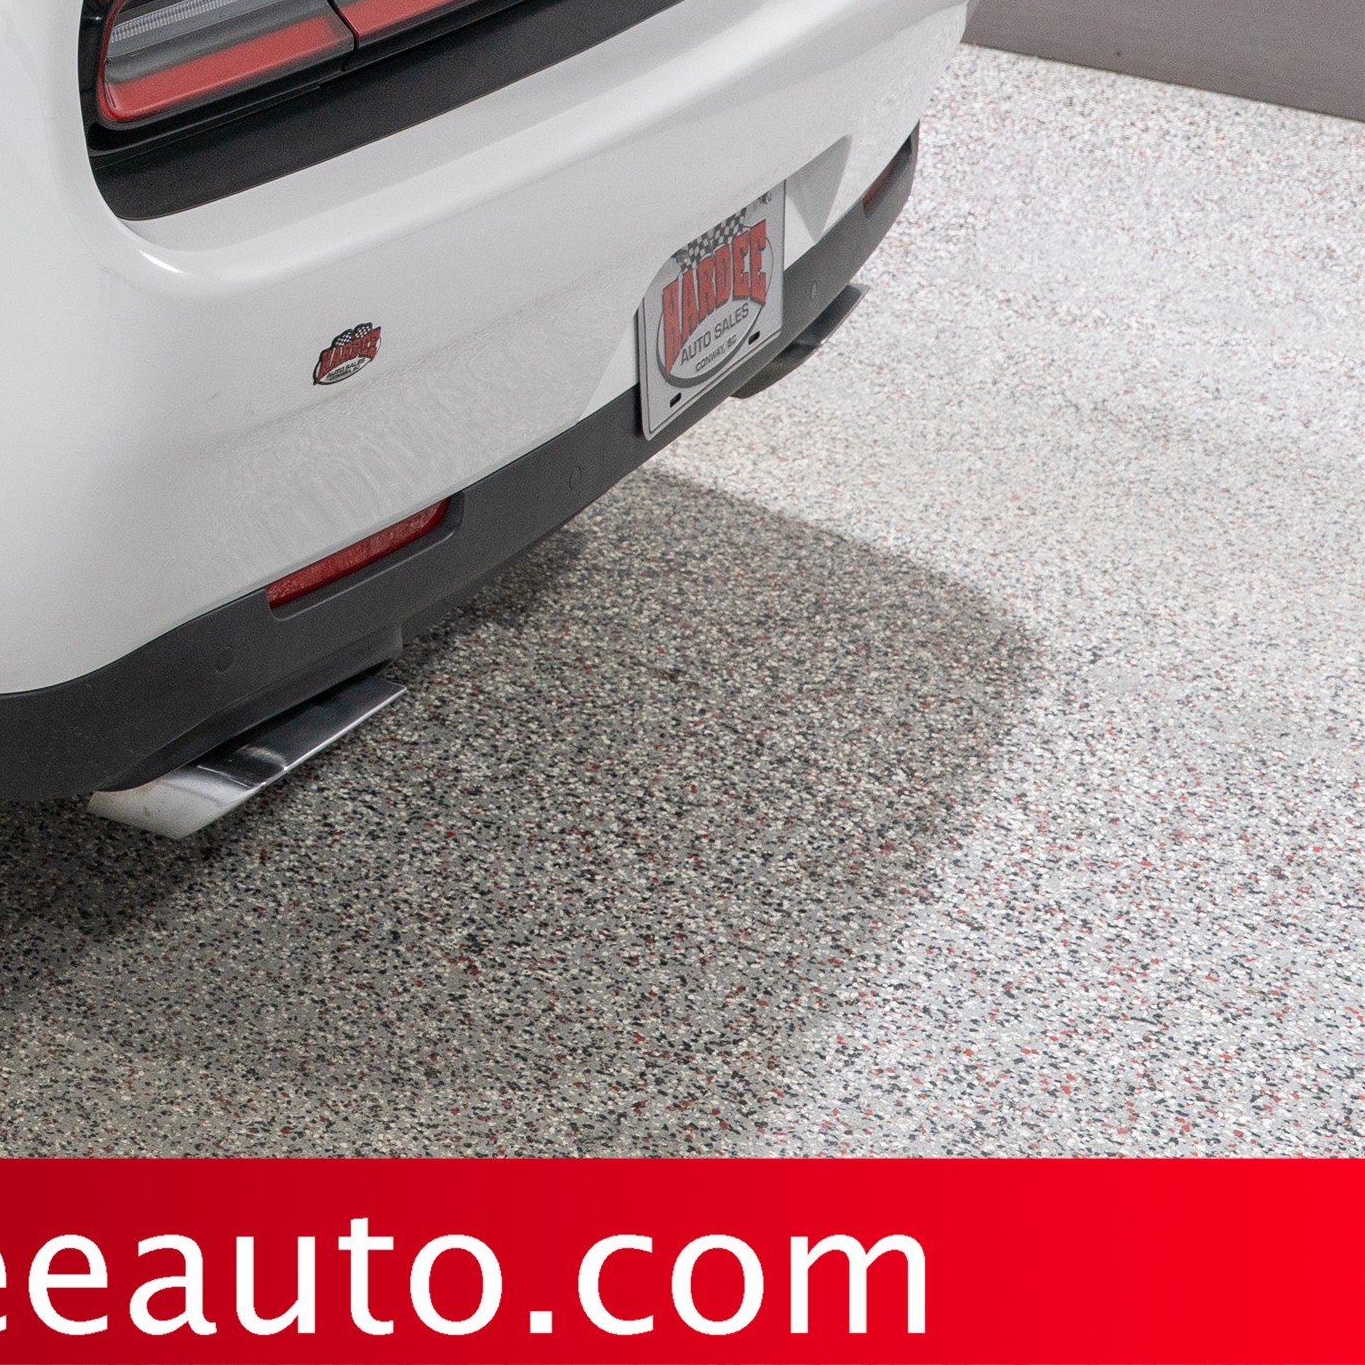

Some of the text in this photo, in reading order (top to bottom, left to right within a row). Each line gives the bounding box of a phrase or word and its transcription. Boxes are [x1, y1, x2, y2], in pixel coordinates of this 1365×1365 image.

[662, 218, 767, 375] HARDEE
[317, 326, 382, 381] HARDEE
[680, 302, 750, 366] AUTO SALES
